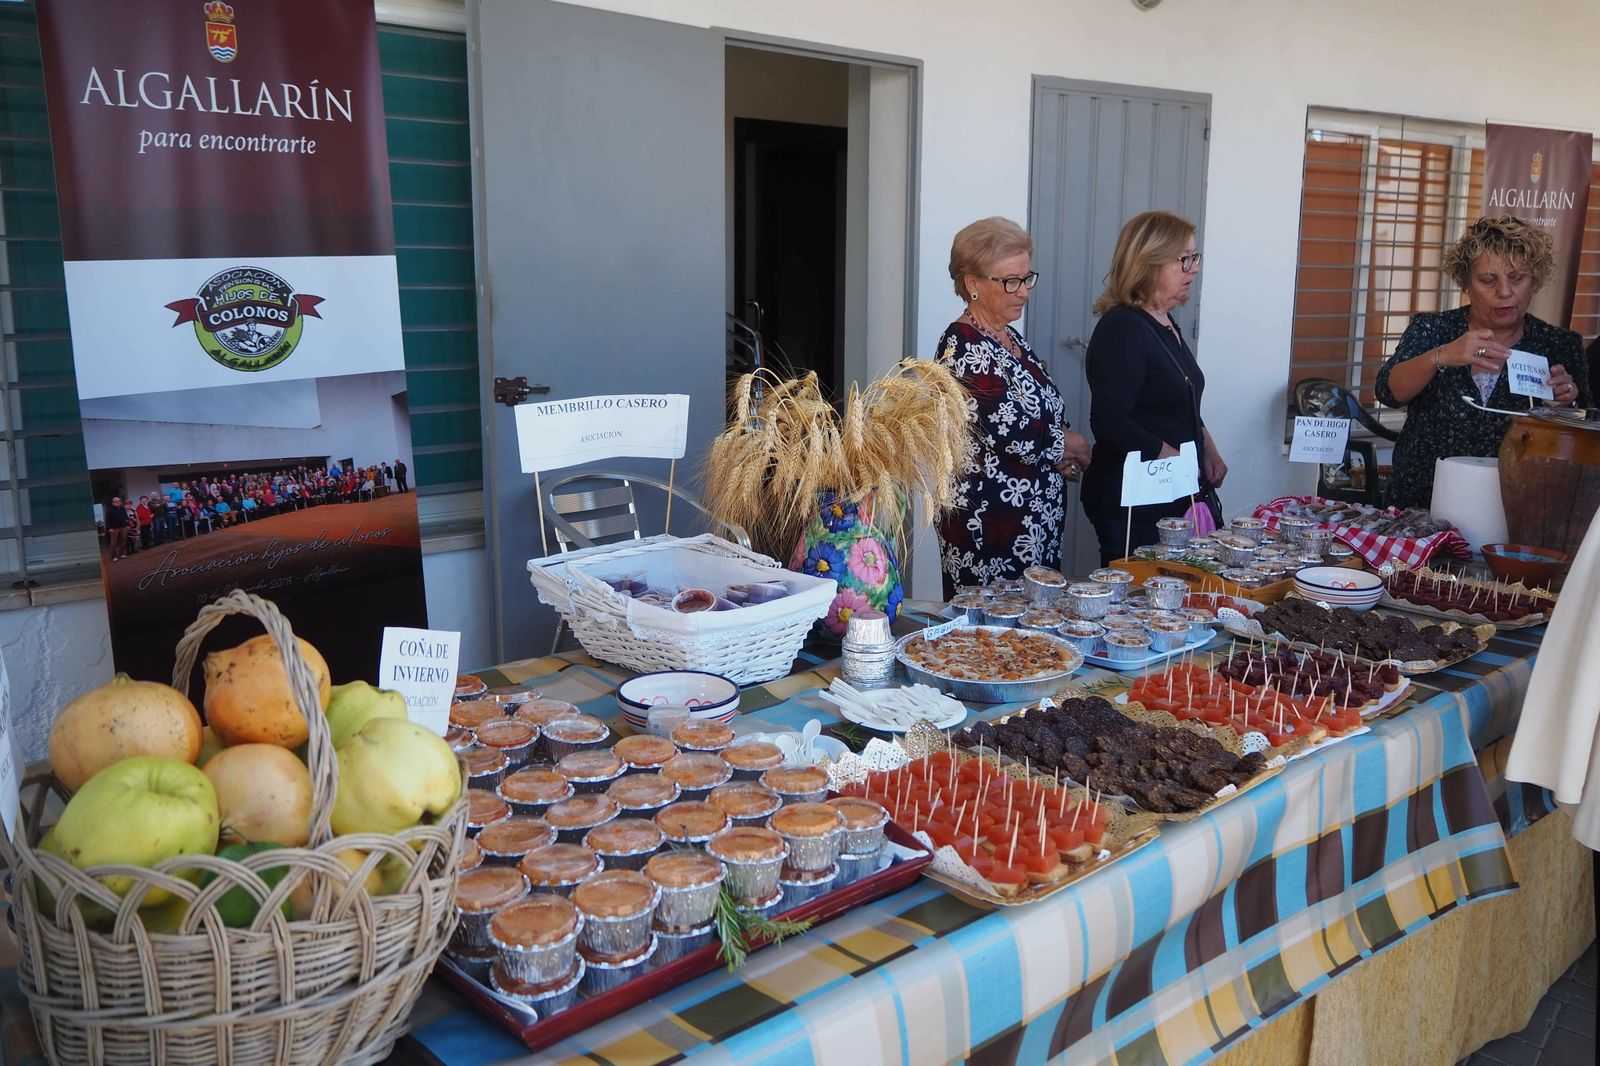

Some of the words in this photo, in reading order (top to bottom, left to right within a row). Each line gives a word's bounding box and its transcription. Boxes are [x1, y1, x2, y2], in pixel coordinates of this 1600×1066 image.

[80, 66, 353, 124] ALGALLARÍN
[139, 129, 192, 154] para
[200, 134, 316, 155] encontrarte
[1488, 188, 1576, 210] ALGALLARÍN
[215, 289, 254, 305] HIJOS
[260, 291, 280, 302] DE
[209, 305, 289, 326] COLONOS
[1511, 363, 1546, 376] ACEITUNAS
[537, 398, 613, 416] MEMBRILLO
[616, 398, 668, 409] CASERO
[1304, 430, 1337, 439] CASERO
[1326, 421, 1347, 429] HIGO
[580, 430, 623, 444] ASOCIACIÓN
[261, 537, 305, 569] hijos
[309, 529, 331, 550] de
[334, 524, 393, 549] colonos
[399, 638, 433, 658] COÑA
[436, 643, 449, 660] DE
[393, 665, 449, 684] INVIERNO
